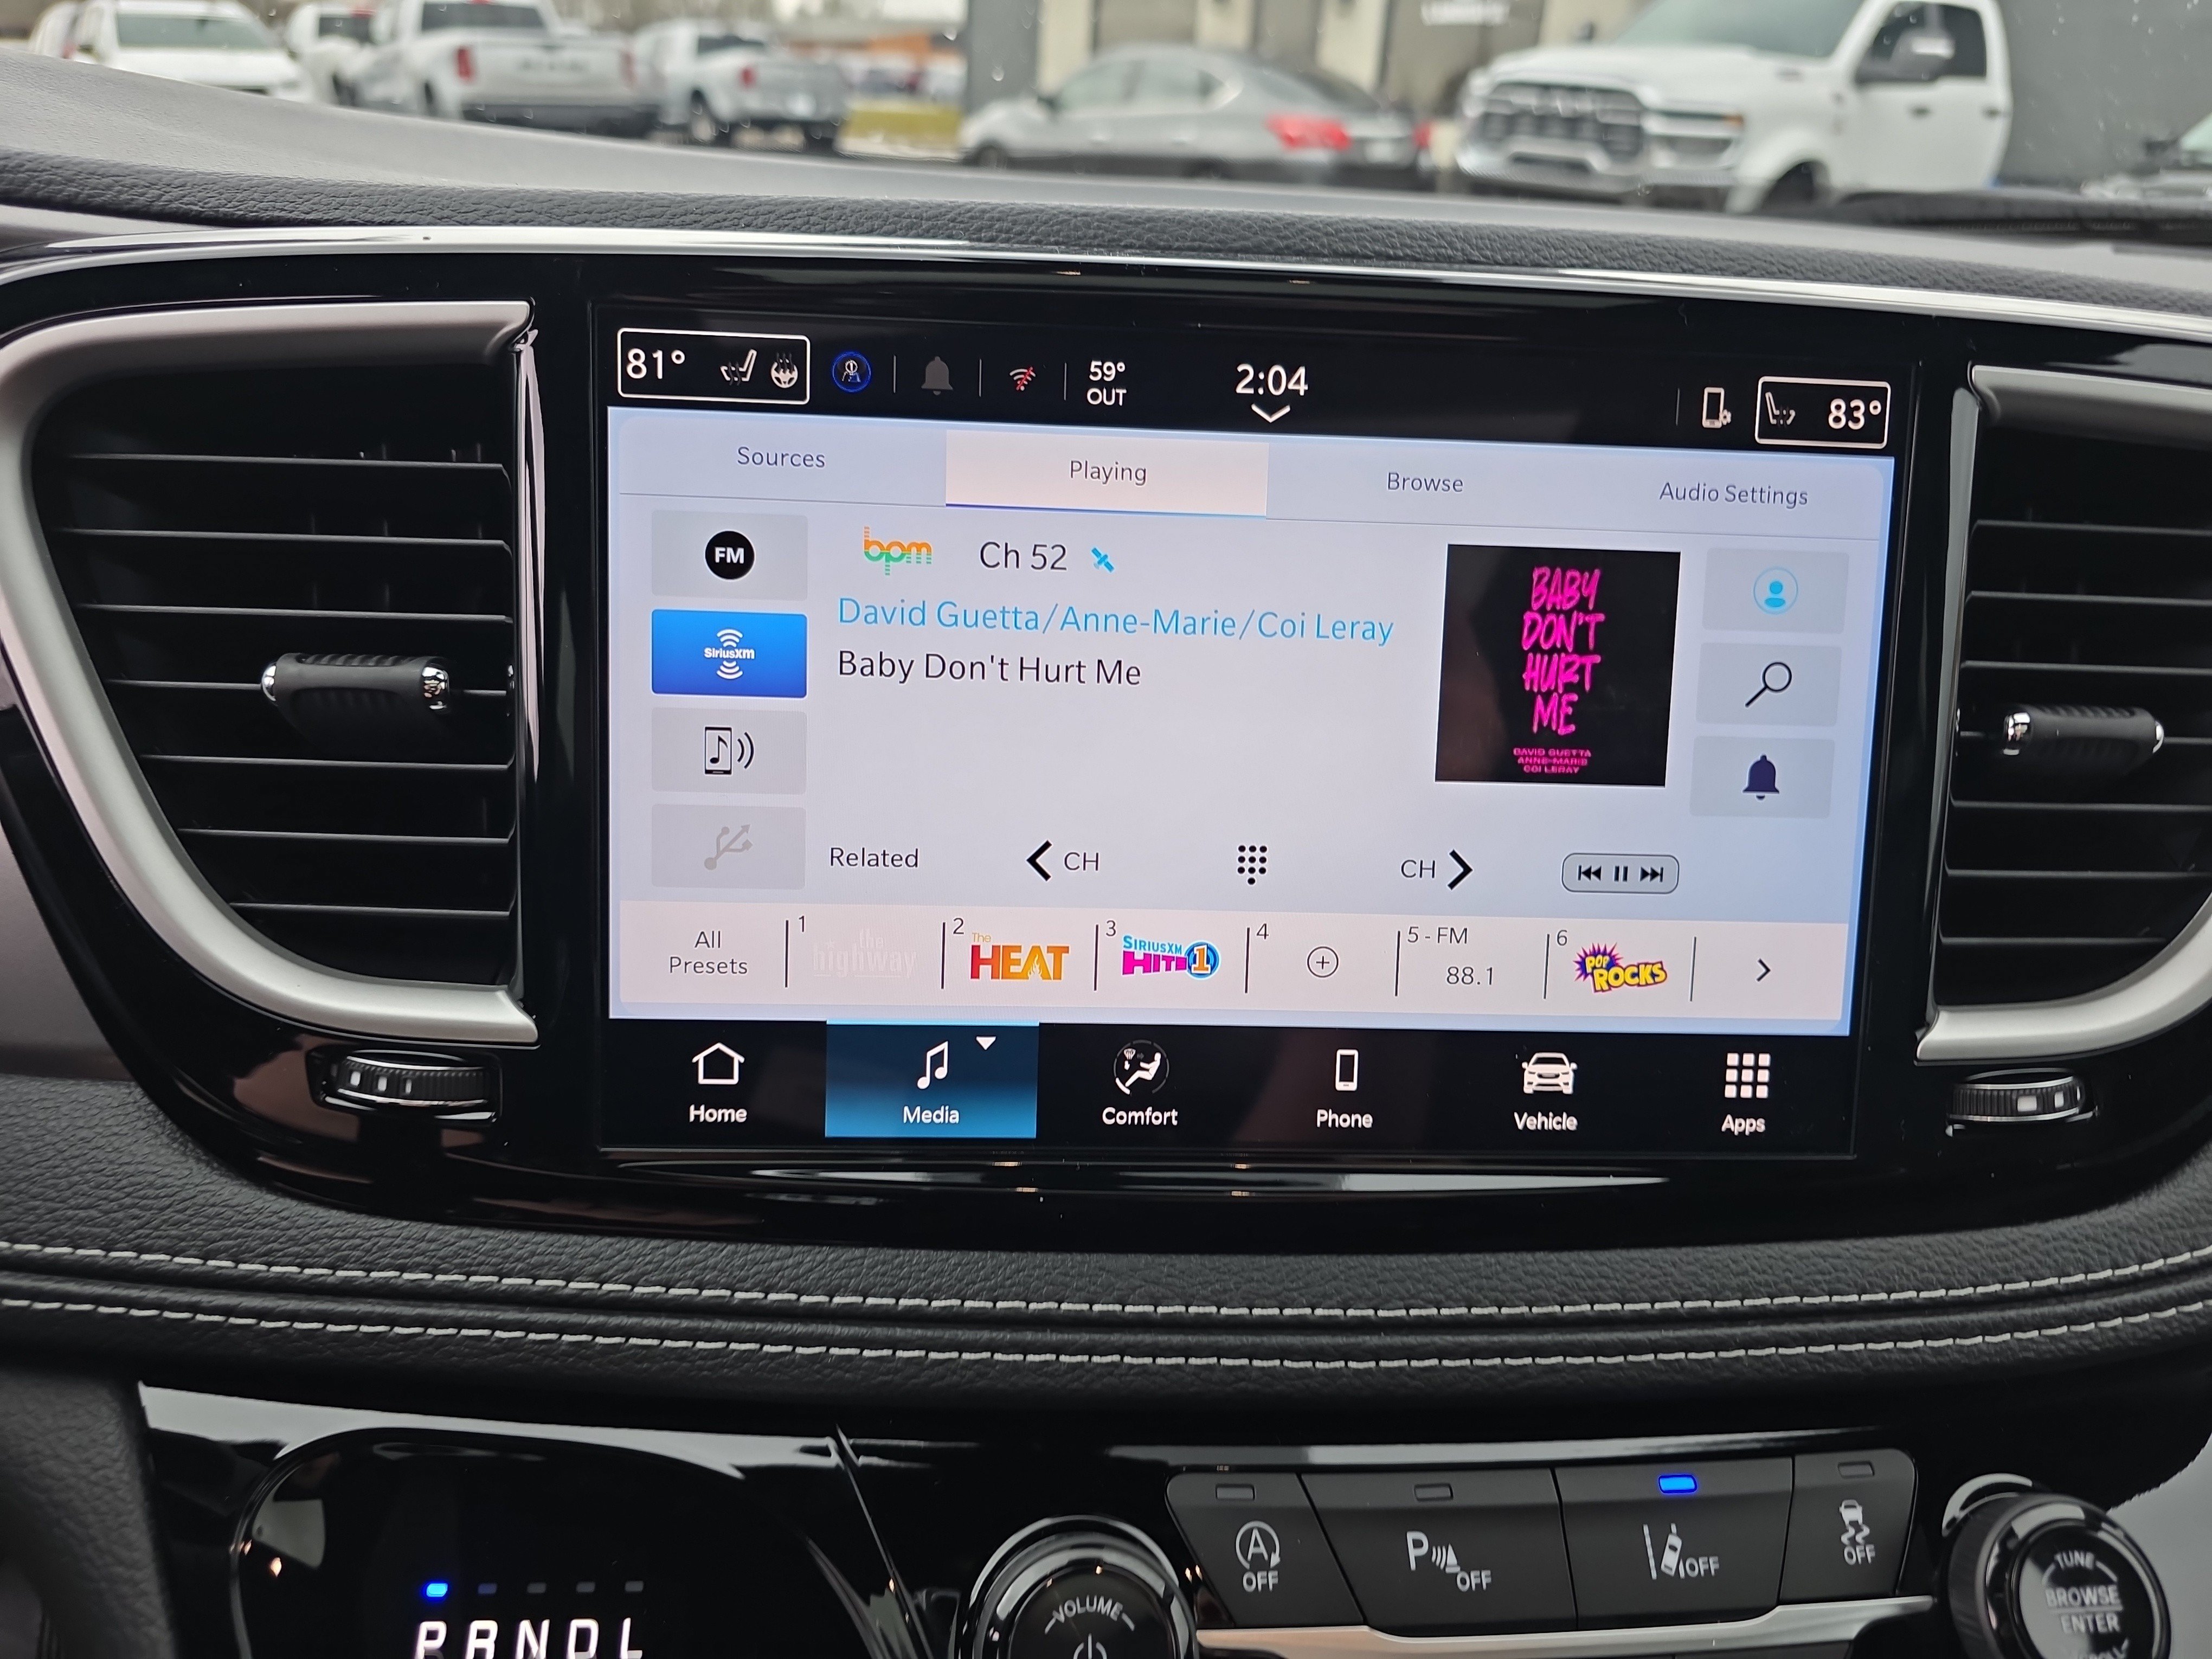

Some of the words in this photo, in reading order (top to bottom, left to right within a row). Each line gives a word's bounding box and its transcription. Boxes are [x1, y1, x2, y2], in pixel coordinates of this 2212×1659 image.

[1235, 364, 1308, 396] 2:04
[1086, 388, 1127, 407] OUT
[737, 446, 826, 468] Sources
[1070, 460, 1147, 485] Playing
[1387, 472, 1464, 492] Browse
[1660, 482, 1719, 502] Audio
[1725, 485, 1808, 509] Settings
[715, 546, 744, 564] FM
[863, 526, 933, 576] bpm
[980, 542, 1020, 569] Ch
[1031, 544, 1067, 571] 52
[1531, 566, 1601, 610] BABY
[839, 597, 926, 626] David
[1316, 614, 1394, 646] Leray
[1521, 610, 1605, 652] DON'T
[839, 651, 914, 684] Baby
[924, 654, 1009, 682] Don't
[1019, 657, 1086, 684] Hurt
[1097, 660, 1141, 685] Me
[1522, 653, 1602, 693] HURT
[1533, 692, 1579, 735] ME
[830, 848, 918, 867] Related
[1064, 852, 1099, 871] CH
[1401, 860, 1436, 878] CH
[798, 915, 806, 933] 1
[953, 917, 964, 935] 2
[1106, 920, 1117, 937] 3
[1256, 924, 1269, 940] 4
[695, 931, 721, 949] All
[972, 933, 991, 942] The
[1407, 927, 1419, 943] 5
[1437, 928, 1468, 944] FM
[1556, 930, 1567, 946] 6
[670, 956, 748, 974] Presets
[970, 945, 1070, 980] HEAT
[1586, 955, 1609, 972] POP
[1446, 967, 1494, 985] 88.1
[1593, 961, 1667, 992] ROCKS
[689, 1105, 747, 1122] Home
[903, 1106, 960, 1124] Media
[1102, 1107, 1178, 1126] Comfort
[1316, 1109, 1373, 1128] Phone
[1514, 1112, 1578, 1130] Vehicle
[1721, 1115, 1765, 1135] Apps
[1843, 1545, 1875, 1565] OFF
[2054, 1550, 2095, 1569] TUNE
[1686, 1557, 1719, 1577] OFF
[1243, 1571, 1278, 1592] OFF
[1456, 1571, 1491, 1591] OFF
[2046, 1585, 2122, 1607] BROWSE
[1052, 1594, 1123, 1623] VOLUME
[2061, 1612, 2120, 1633] ENTER
